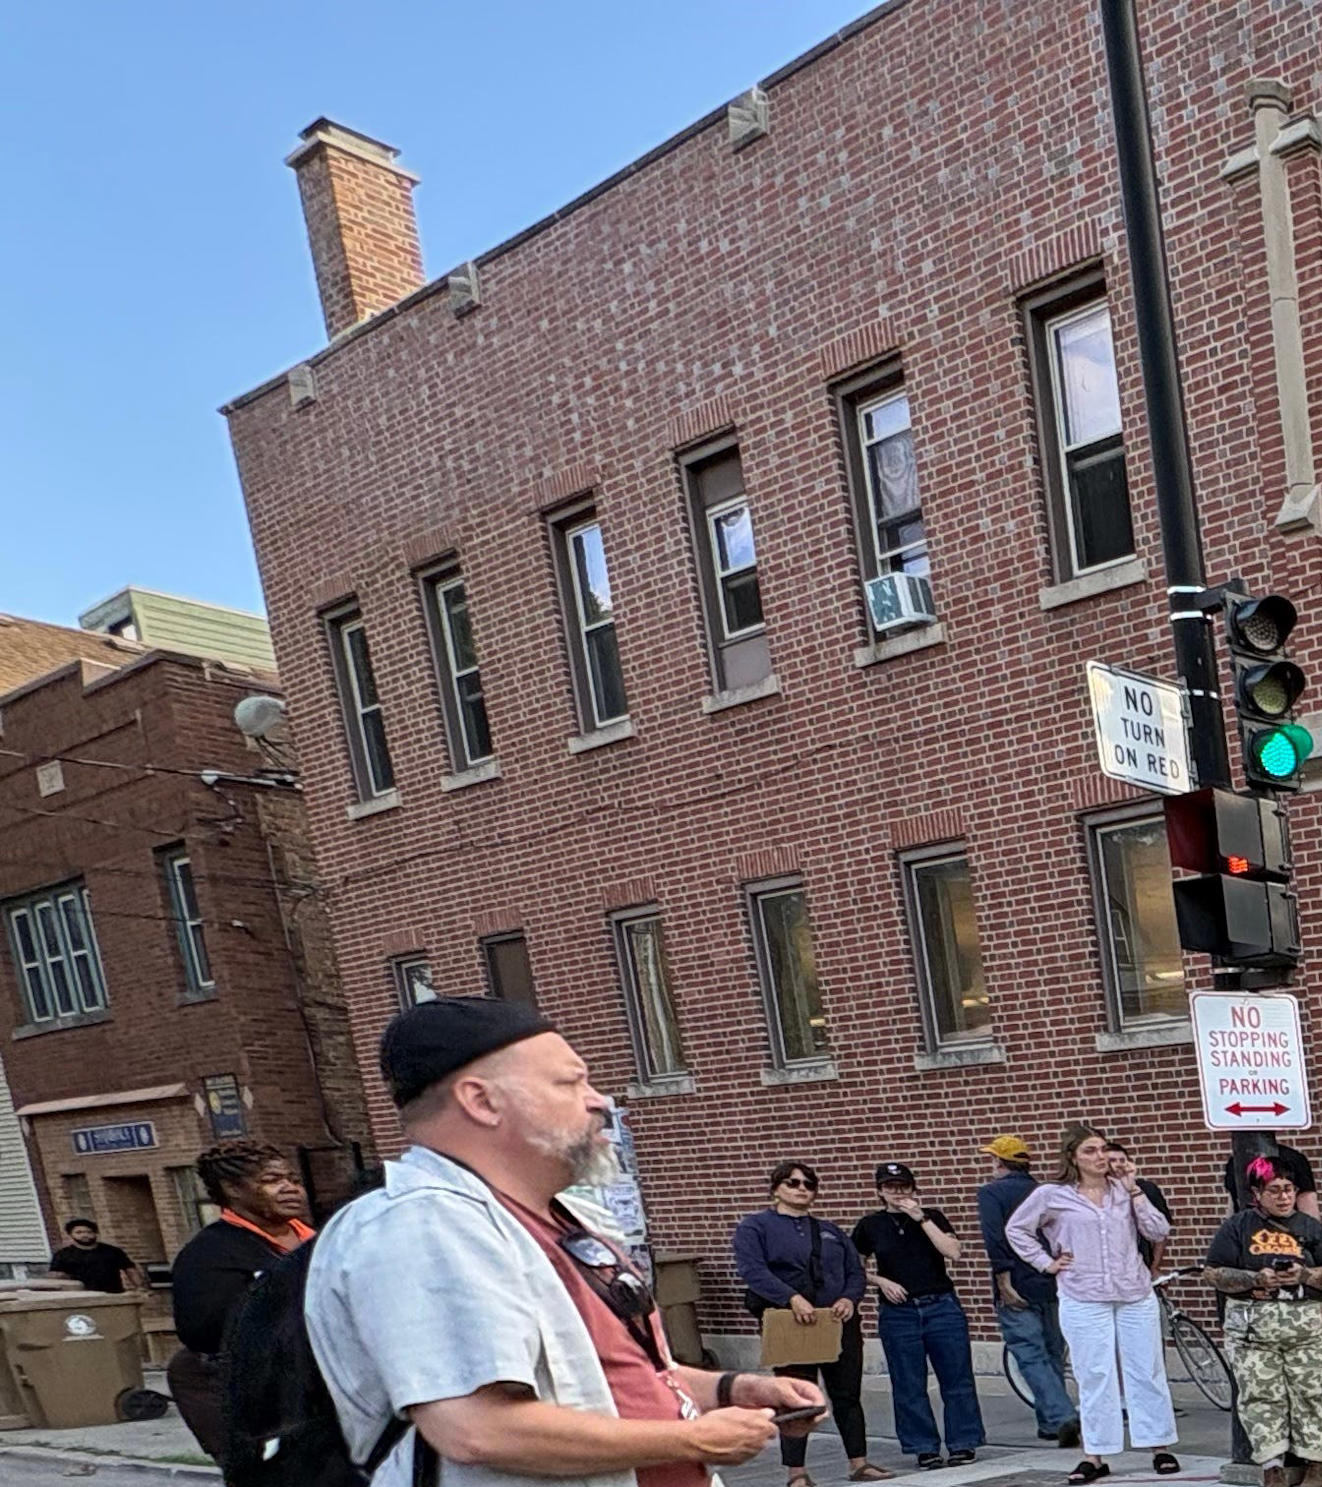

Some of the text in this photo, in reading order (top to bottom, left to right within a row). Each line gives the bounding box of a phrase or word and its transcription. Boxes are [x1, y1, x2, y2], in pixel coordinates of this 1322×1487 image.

[1124, 686, 1153, 716] NO
[1121, 718, 1165, 748] TURN
[1115, 745, 1180, 779] ON RED
[1231, 1007, 1261, 1029] NO
[1209, 1030, 1289, 1048] STOPPING
[1210, 1051, 1292, 1068] STANDING
[1219, 1078, 1290, 1096] PARKING
